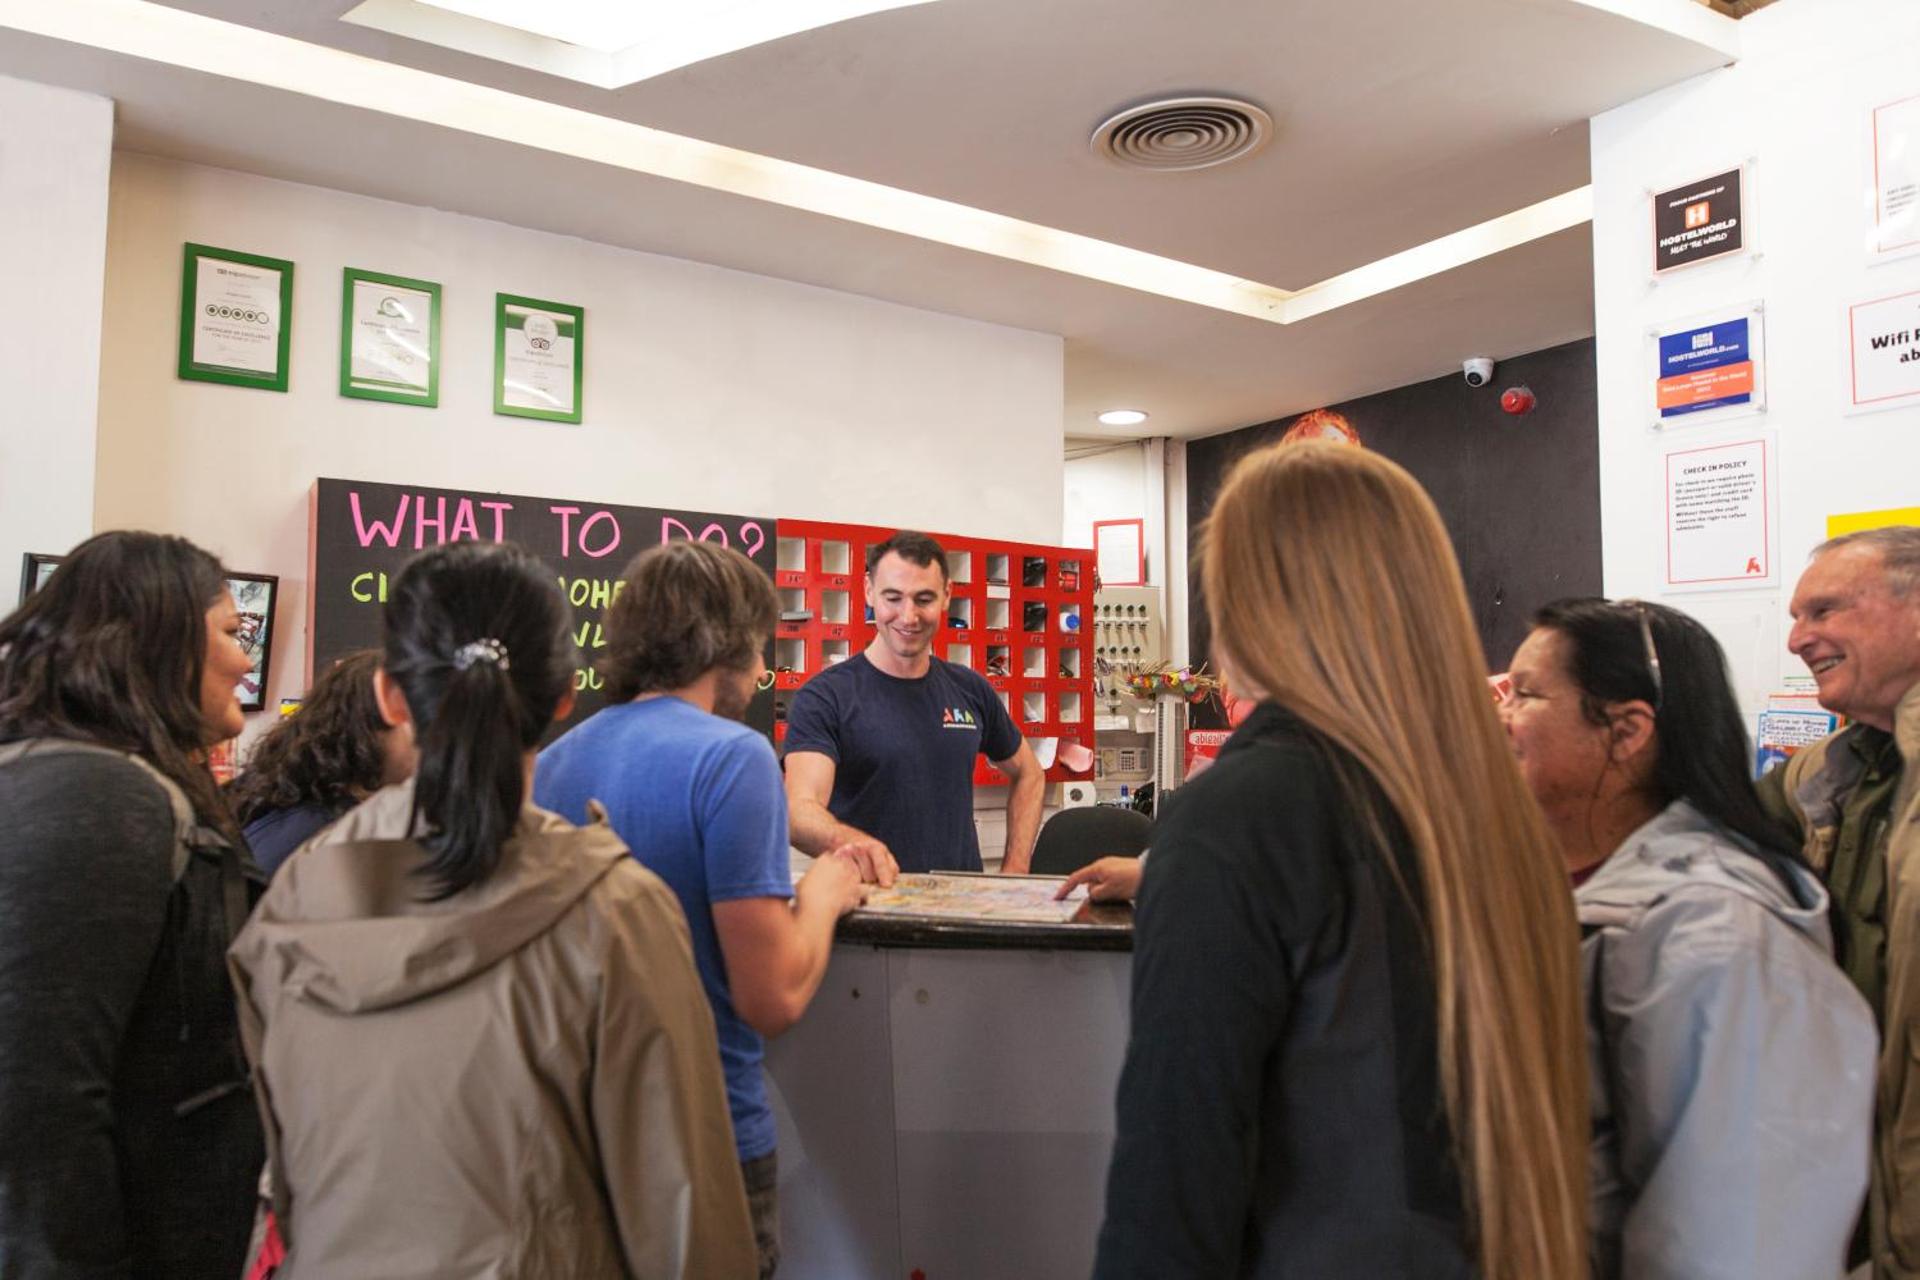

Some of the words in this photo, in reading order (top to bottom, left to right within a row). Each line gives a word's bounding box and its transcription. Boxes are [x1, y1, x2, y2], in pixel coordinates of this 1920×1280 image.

[1660, 219, 1737, 247] HOSTELWORLD
[1871, 330, 1909, 350] Wifi
[1668, 344, 1739, 363] HOSTELWORLD.com
[1683, 465, 1706, 475] CHECK
[1708, 464, 1717, 472] IN
[1718, 461, 1747, 470] POLICY
[349, 492, 513, 549] WHAT
[550, 506, 621, 558] TO
[558, 576, 626, 610] OH
